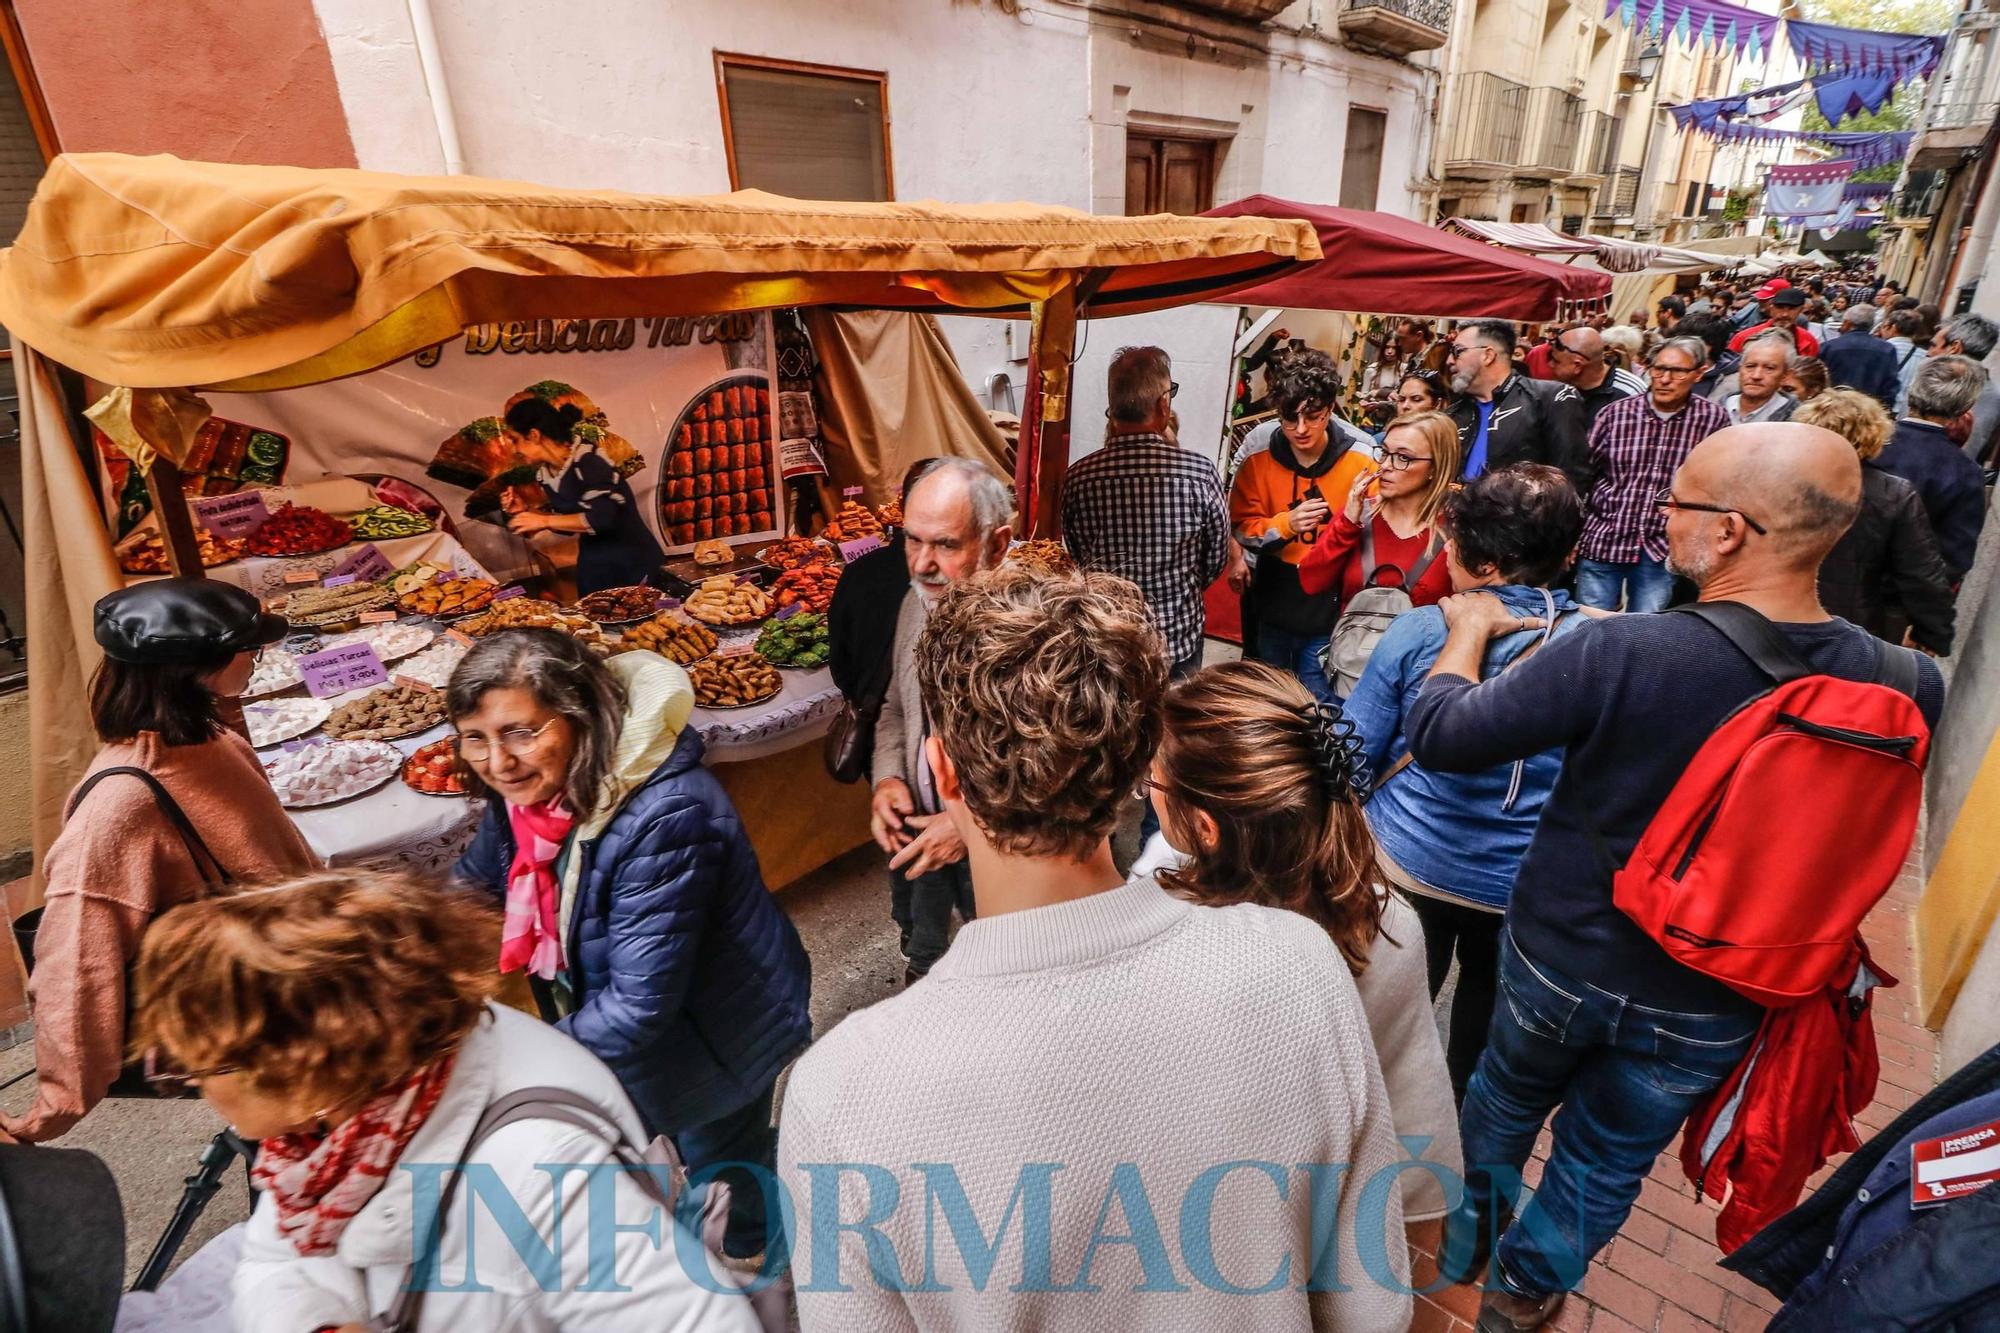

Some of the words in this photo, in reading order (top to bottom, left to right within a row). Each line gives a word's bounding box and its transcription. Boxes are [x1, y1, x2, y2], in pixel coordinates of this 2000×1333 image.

[302, 658, 338, 671] Delicias
[338, 650, 371, 661] Turcas
[348, 669, 378, 682] 3.90€
